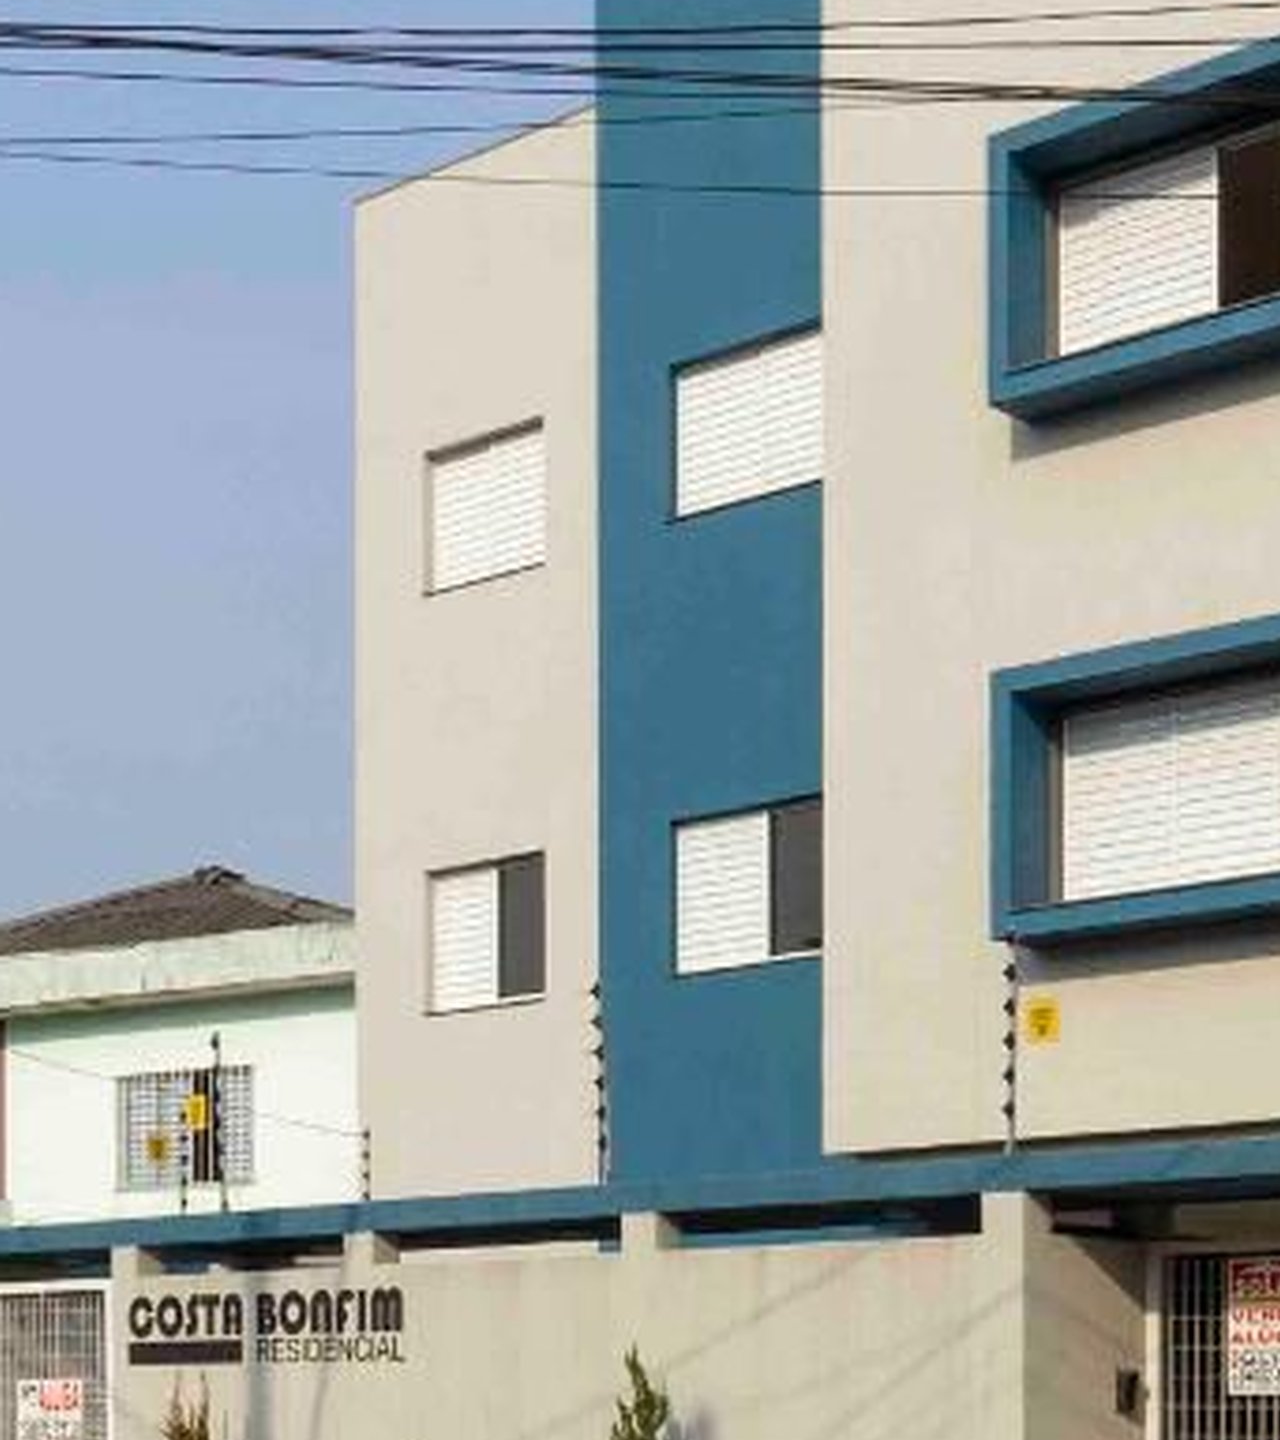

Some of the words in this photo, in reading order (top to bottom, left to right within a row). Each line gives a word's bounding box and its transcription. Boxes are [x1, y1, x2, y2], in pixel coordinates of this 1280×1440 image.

[129, 1293, 242, 1338] COSTA
[256, 1286, 404, 1335] BONFIM
[256, 1336, 407, 1363] RESIDENCIAL
